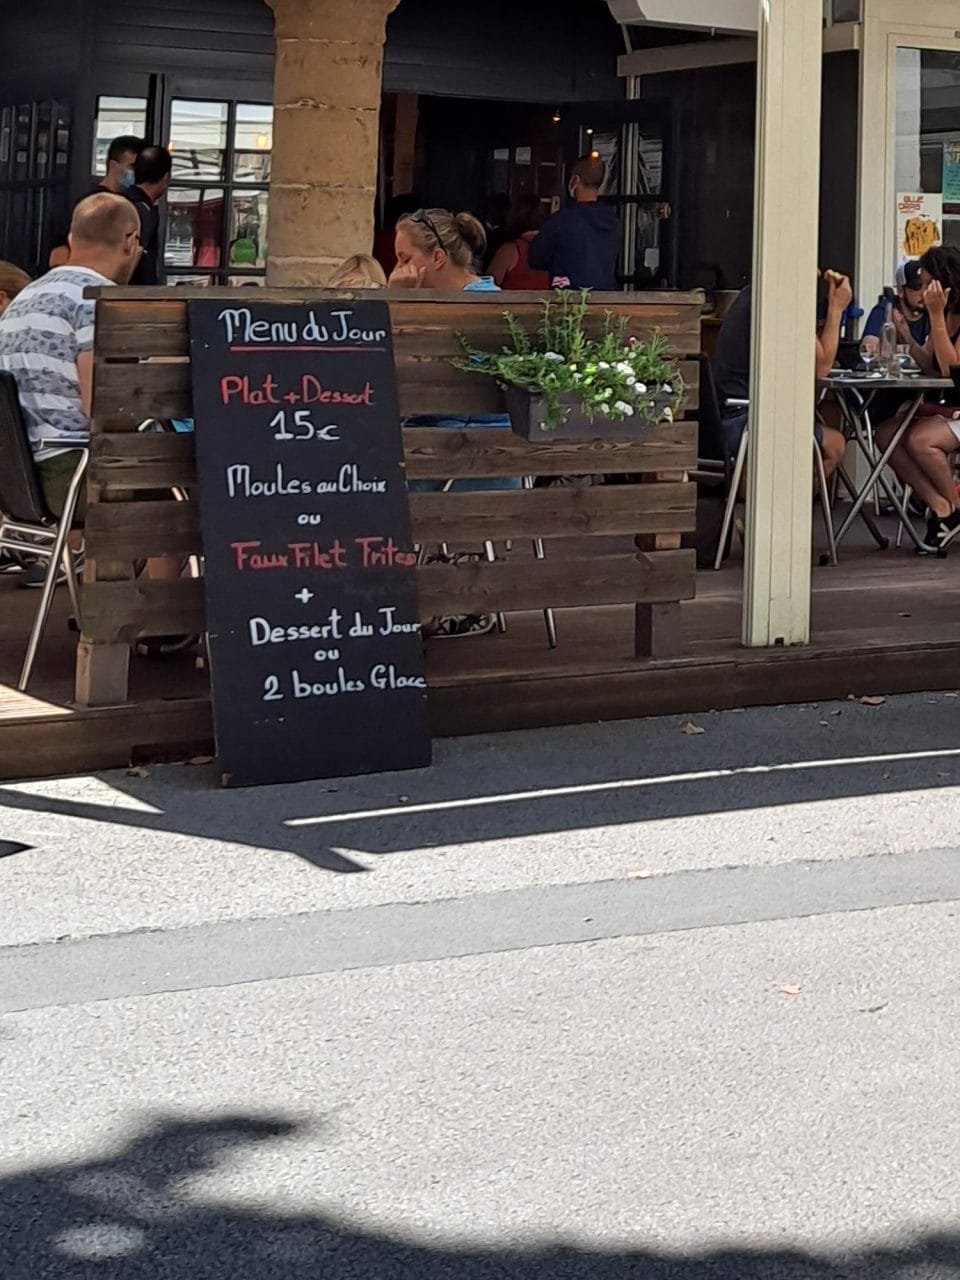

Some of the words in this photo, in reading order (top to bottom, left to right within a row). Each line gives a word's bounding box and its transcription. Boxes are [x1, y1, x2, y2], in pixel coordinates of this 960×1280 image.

[218, 308, 297, 343] Menu
[302, 310, 328, 342] du
[331, 310, 386, 342] Jour
[220, 373, 279, 405] Plat
[301, 374, 376, 405] Dessert
[226, 463, 312, 497] Moules
[316, 481, 338, 494] au
[338, 463, 387, 493] Choix
[297, 513, 321, 525] ou
[249, 608, 343, 646] Dessert
[349, 611, 374, 637] du
[378, 607, 421, 636] Jour
[313, 648, 340, 661] ou
[262, 674, 285, 701] 2
[292, 666, 366, 698] boules
